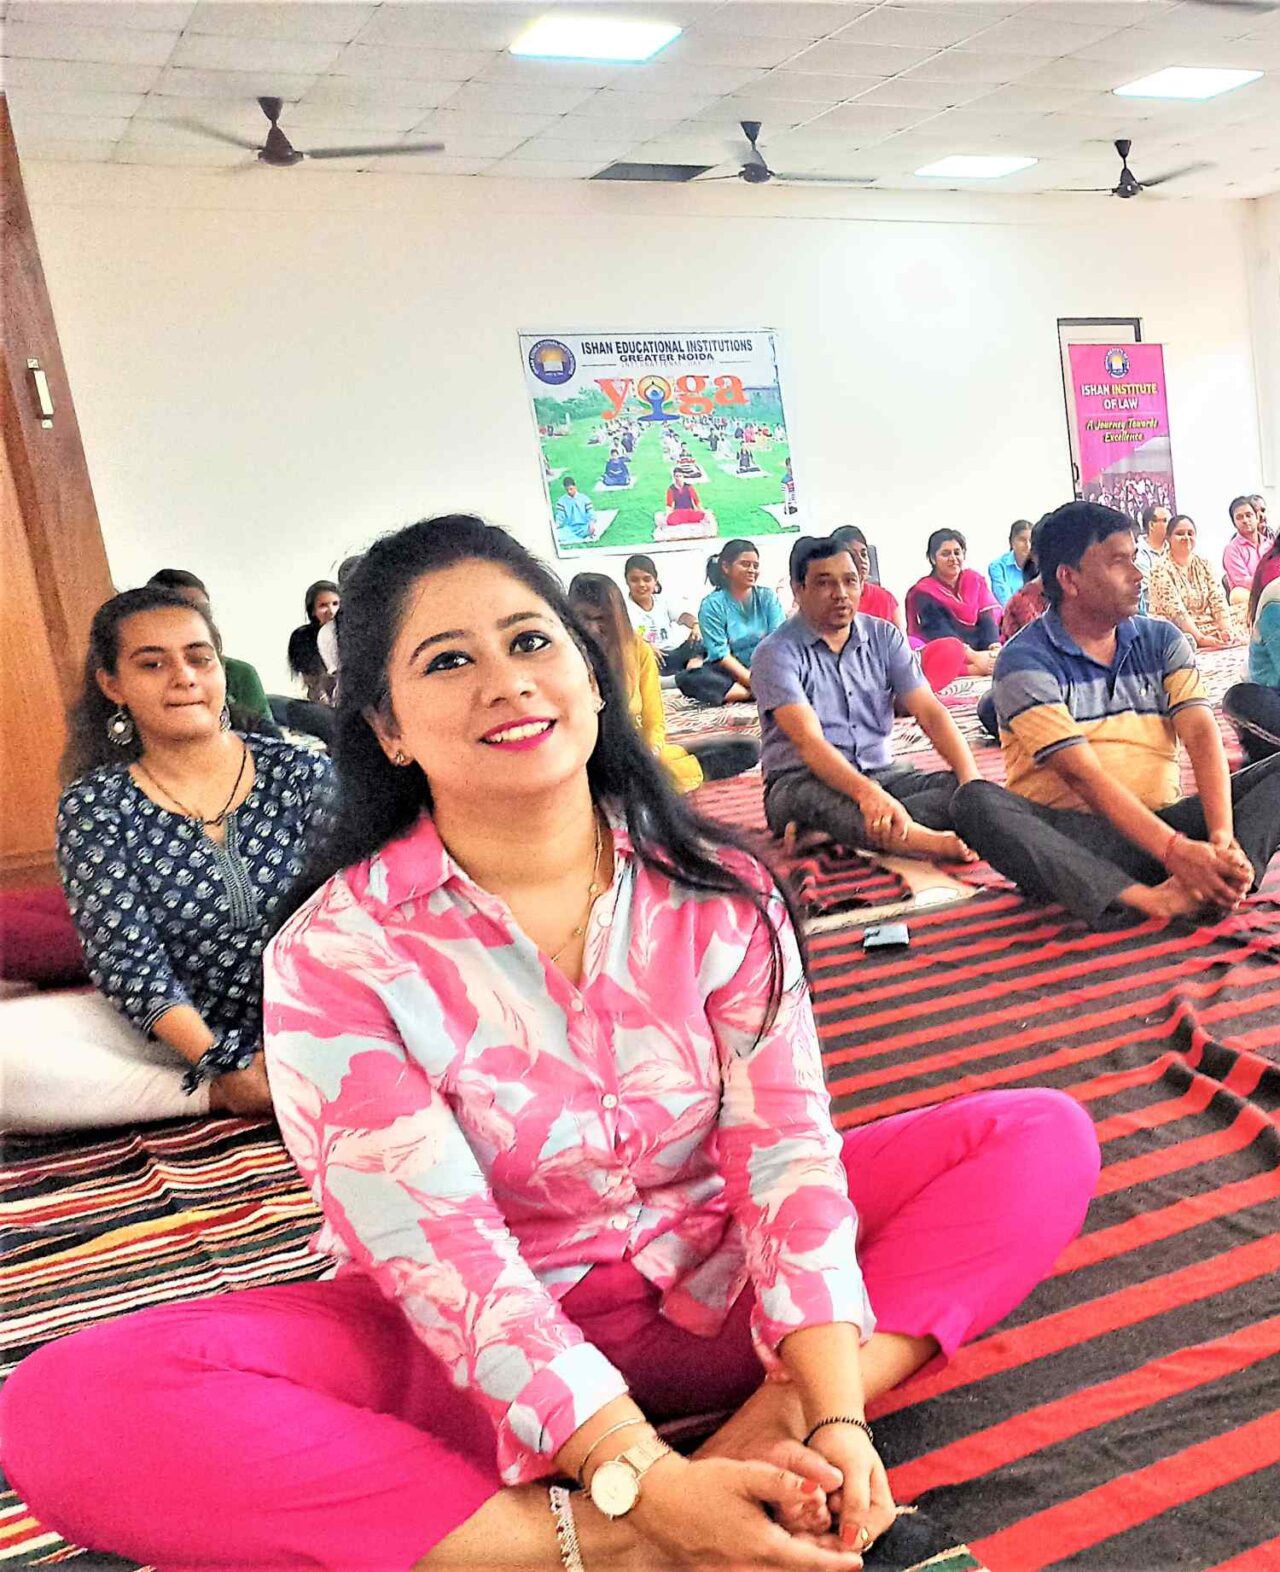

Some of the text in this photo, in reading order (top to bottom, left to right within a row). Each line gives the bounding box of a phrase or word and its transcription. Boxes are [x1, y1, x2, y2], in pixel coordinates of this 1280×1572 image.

[581, 339, 753, 355] ISHAN EDUCATIONAL INSTITUTIONS
[619, 353, 715, 363] GREATER NOIDA
[1081, 383, 1158, 396] ISHAN INSTITUTE
[594, 374, 749, 421] yoga
[1104, 398, 1138, 410] OF LAW
